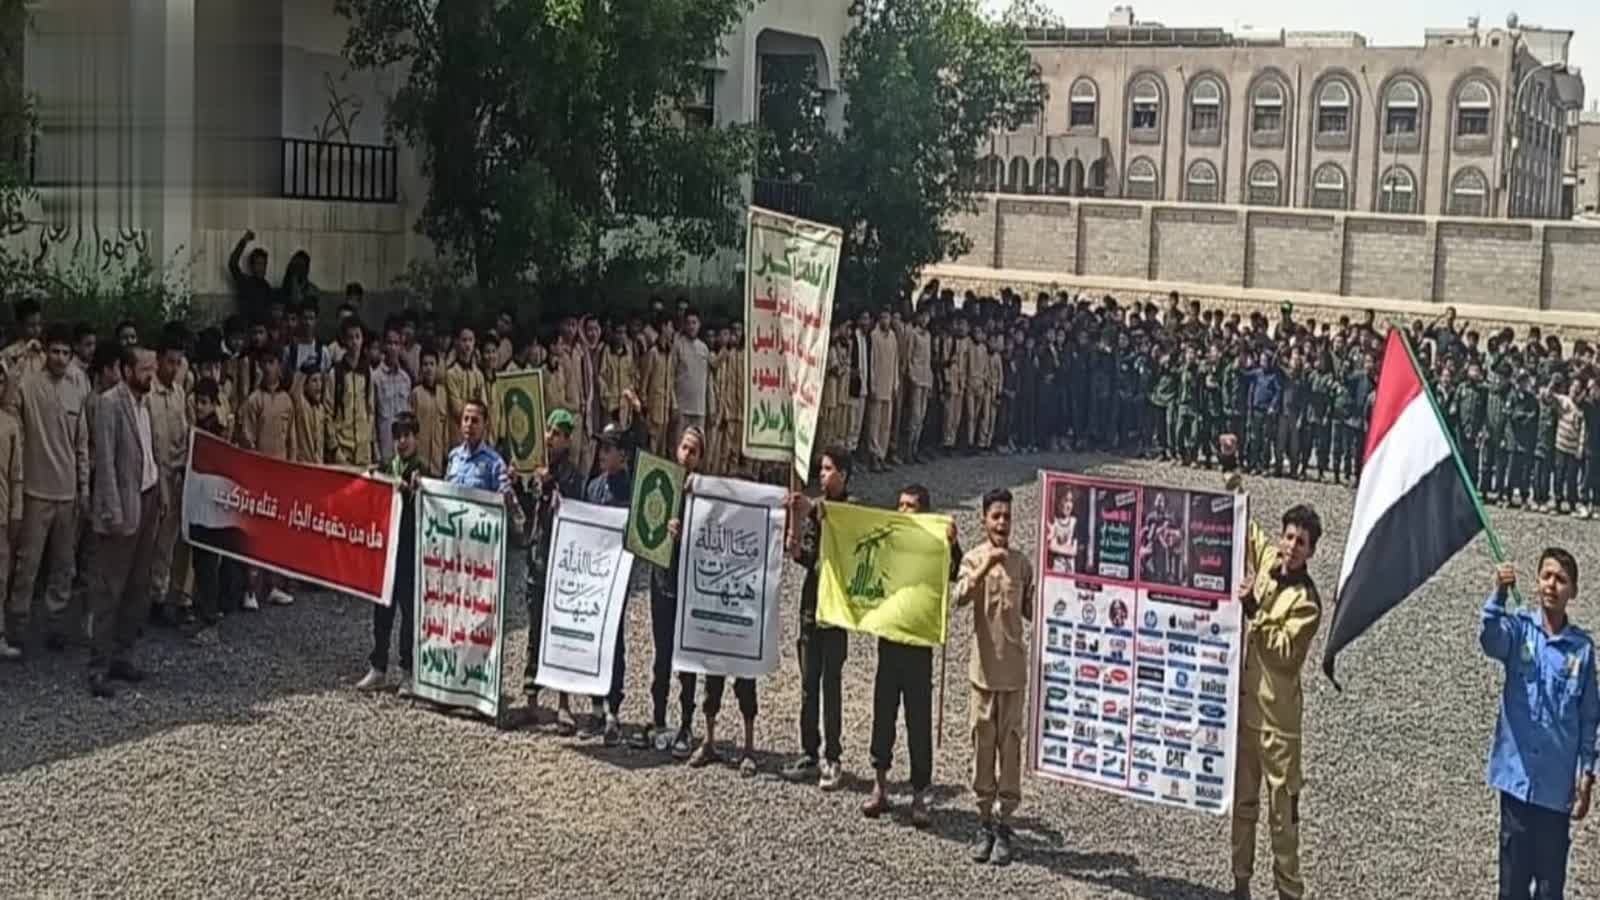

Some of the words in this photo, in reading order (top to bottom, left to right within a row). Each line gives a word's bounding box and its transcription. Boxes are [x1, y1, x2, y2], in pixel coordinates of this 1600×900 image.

[801, 249, 831, 289] الله
[288, 499, 313, 531] الجار
[469, 512, 499, 543] الله
[348, 522, 365, 544] من
[366, 521, 384, 549] هل
[1168, 642, 1197, 658] DELL
[1166, 748, 1186, 768] CAT
